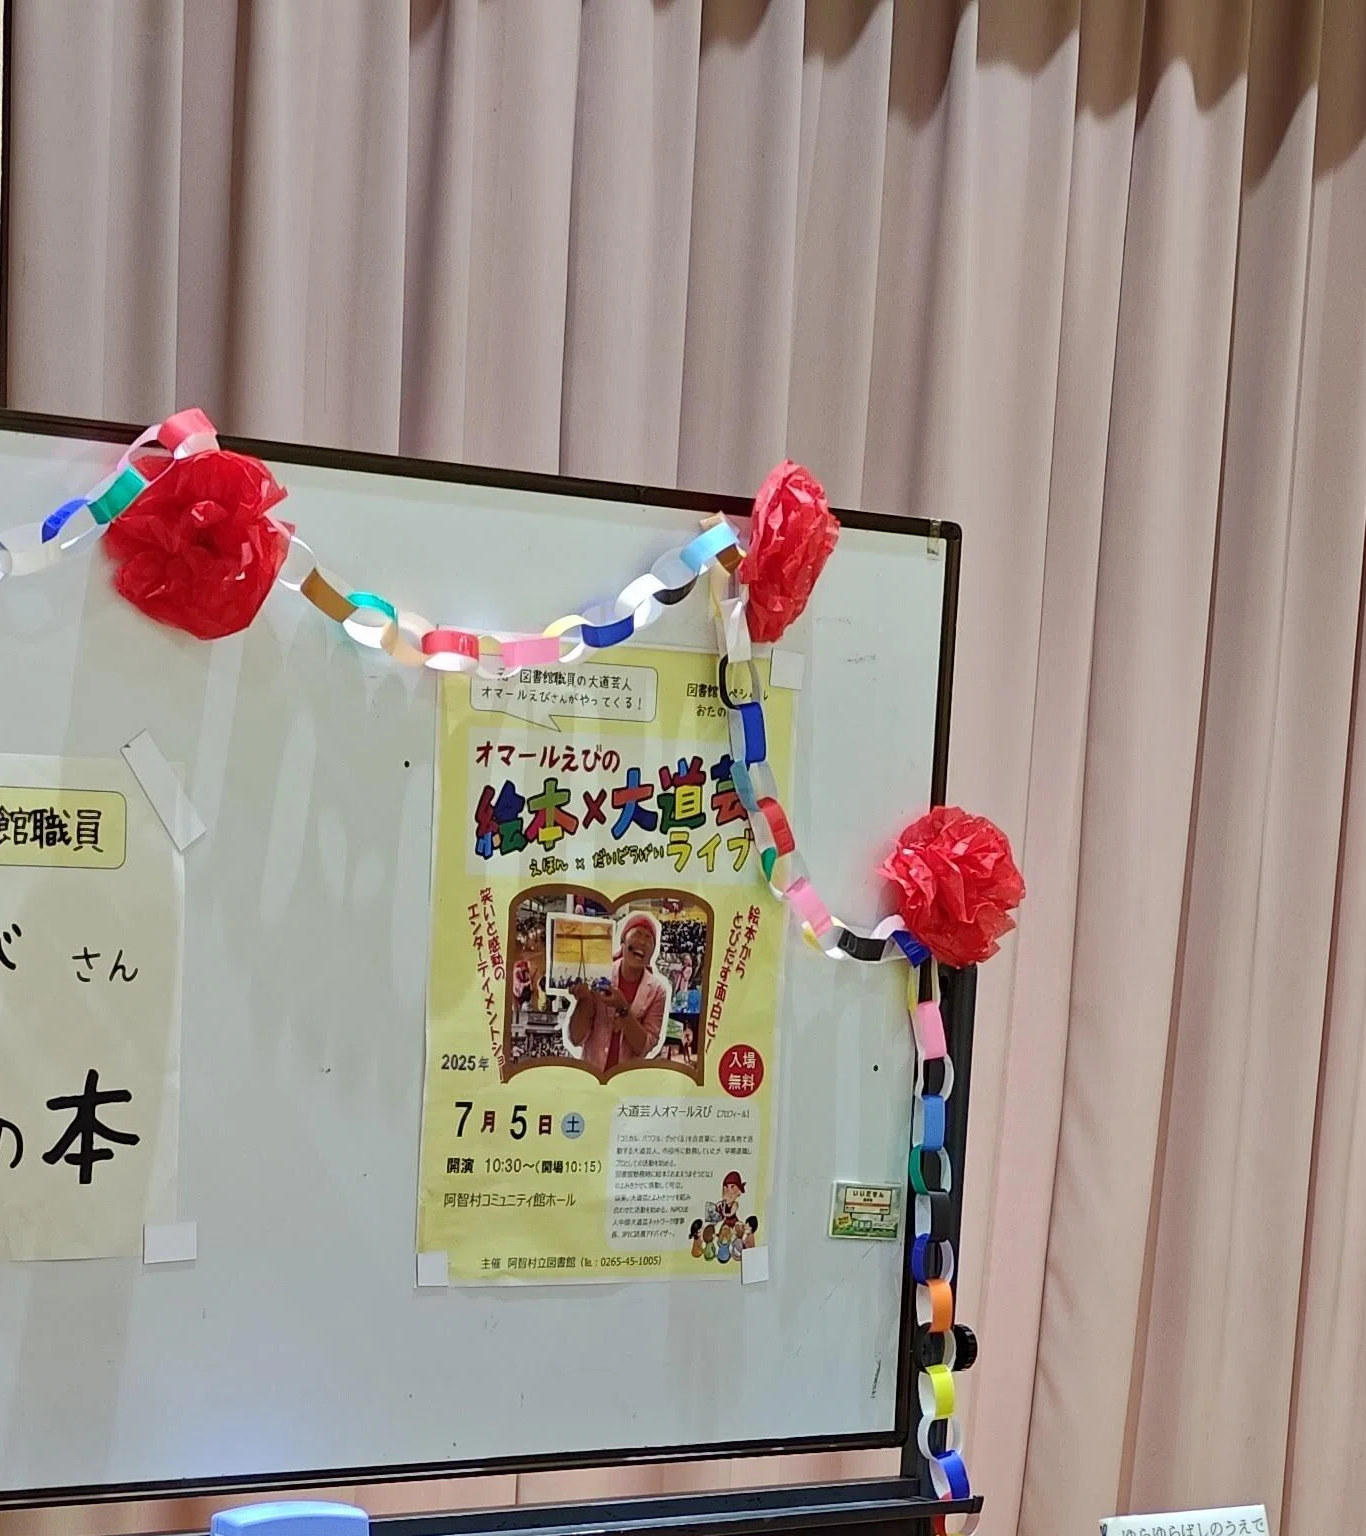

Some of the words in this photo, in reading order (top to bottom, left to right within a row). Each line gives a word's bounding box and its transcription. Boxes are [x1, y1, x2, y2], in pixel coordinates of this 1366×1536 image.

[476, 741, 620, 773] オマールえびの
[666, 828, 755, 872] ライブ
[735, 905, 761, 979] 絵本から
[71, 945, 139, 983] さん
[441, 1053, 490, 1071] 2025年
[729, 1051, 756, 1070] 入場
[728, 1073, 755, 1091] 無料
[566, 1115, 580, 1133] 土
[446, 1157, 475, 1174] 開演
[443, 1192, 577, 1208] 阿智村コミュニティ館ホール
[481, 1258, 502, 1270] 主催
[507, 1256, 577, 1270] 阿智村立図書館
